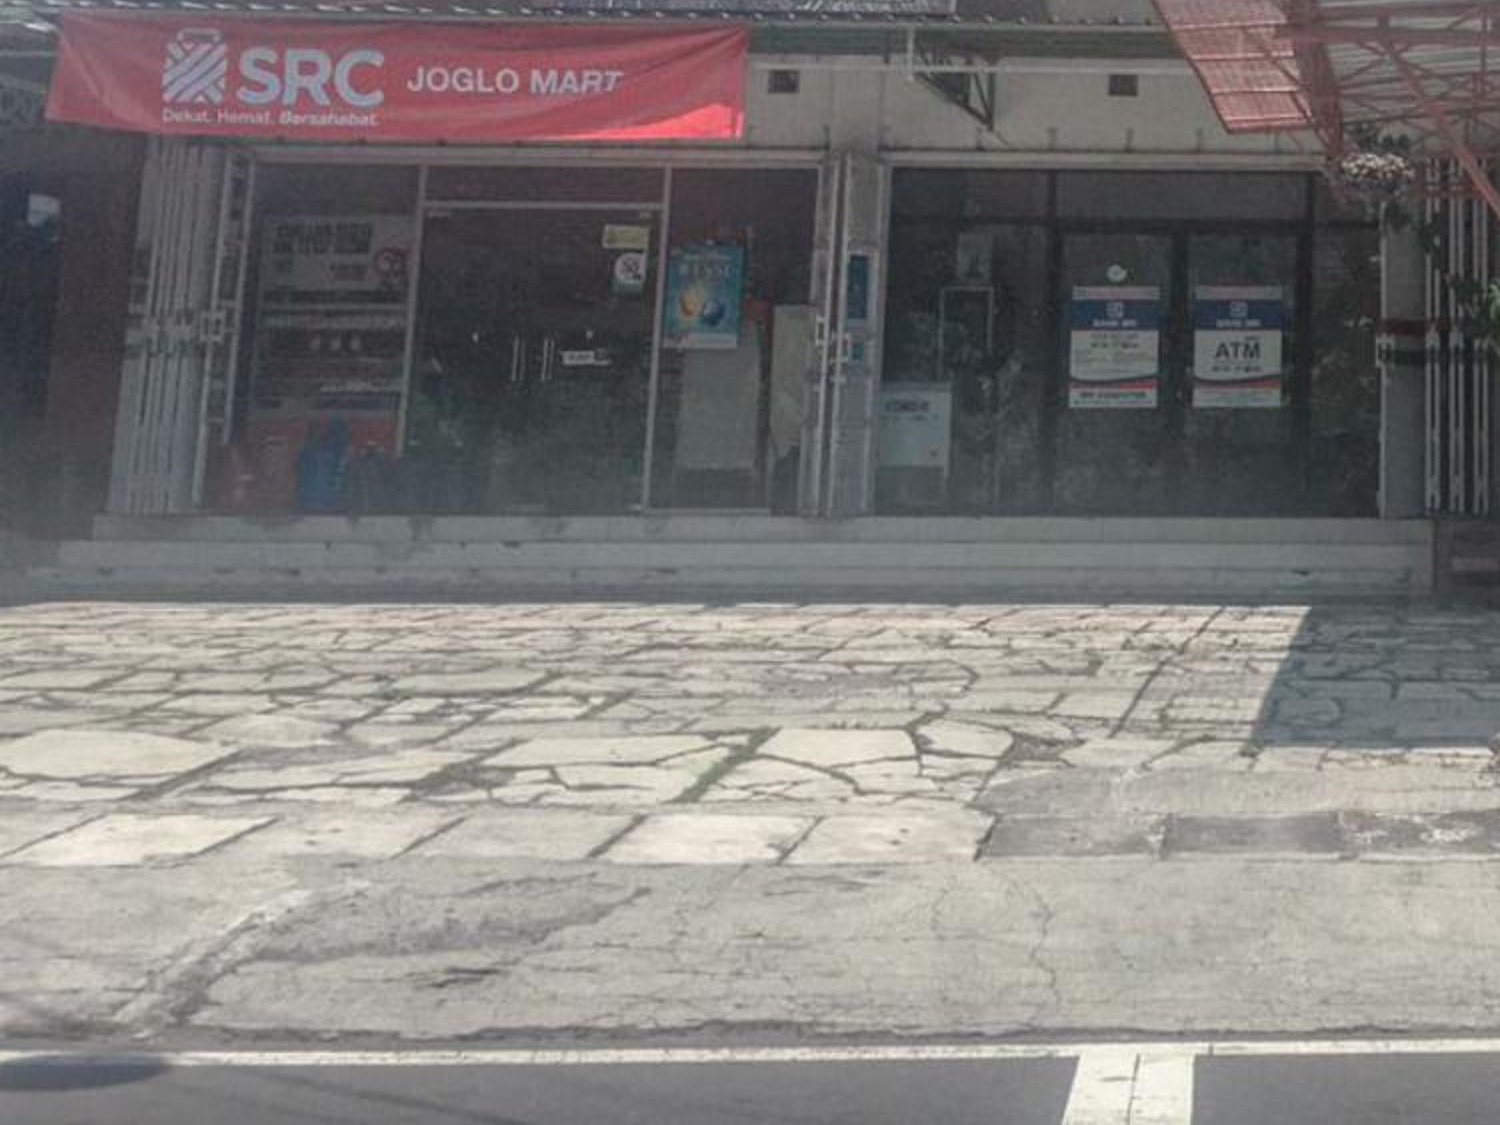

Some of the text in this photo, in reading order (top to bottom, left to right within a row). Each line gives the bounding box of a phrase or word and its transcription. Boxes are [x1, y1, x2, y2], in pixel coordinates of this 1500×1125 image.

[236, 47, 385, 106] SRC
[407, 65, 624, 95] JOGLO MART
[1214, 341, 1262, 360] ATM
